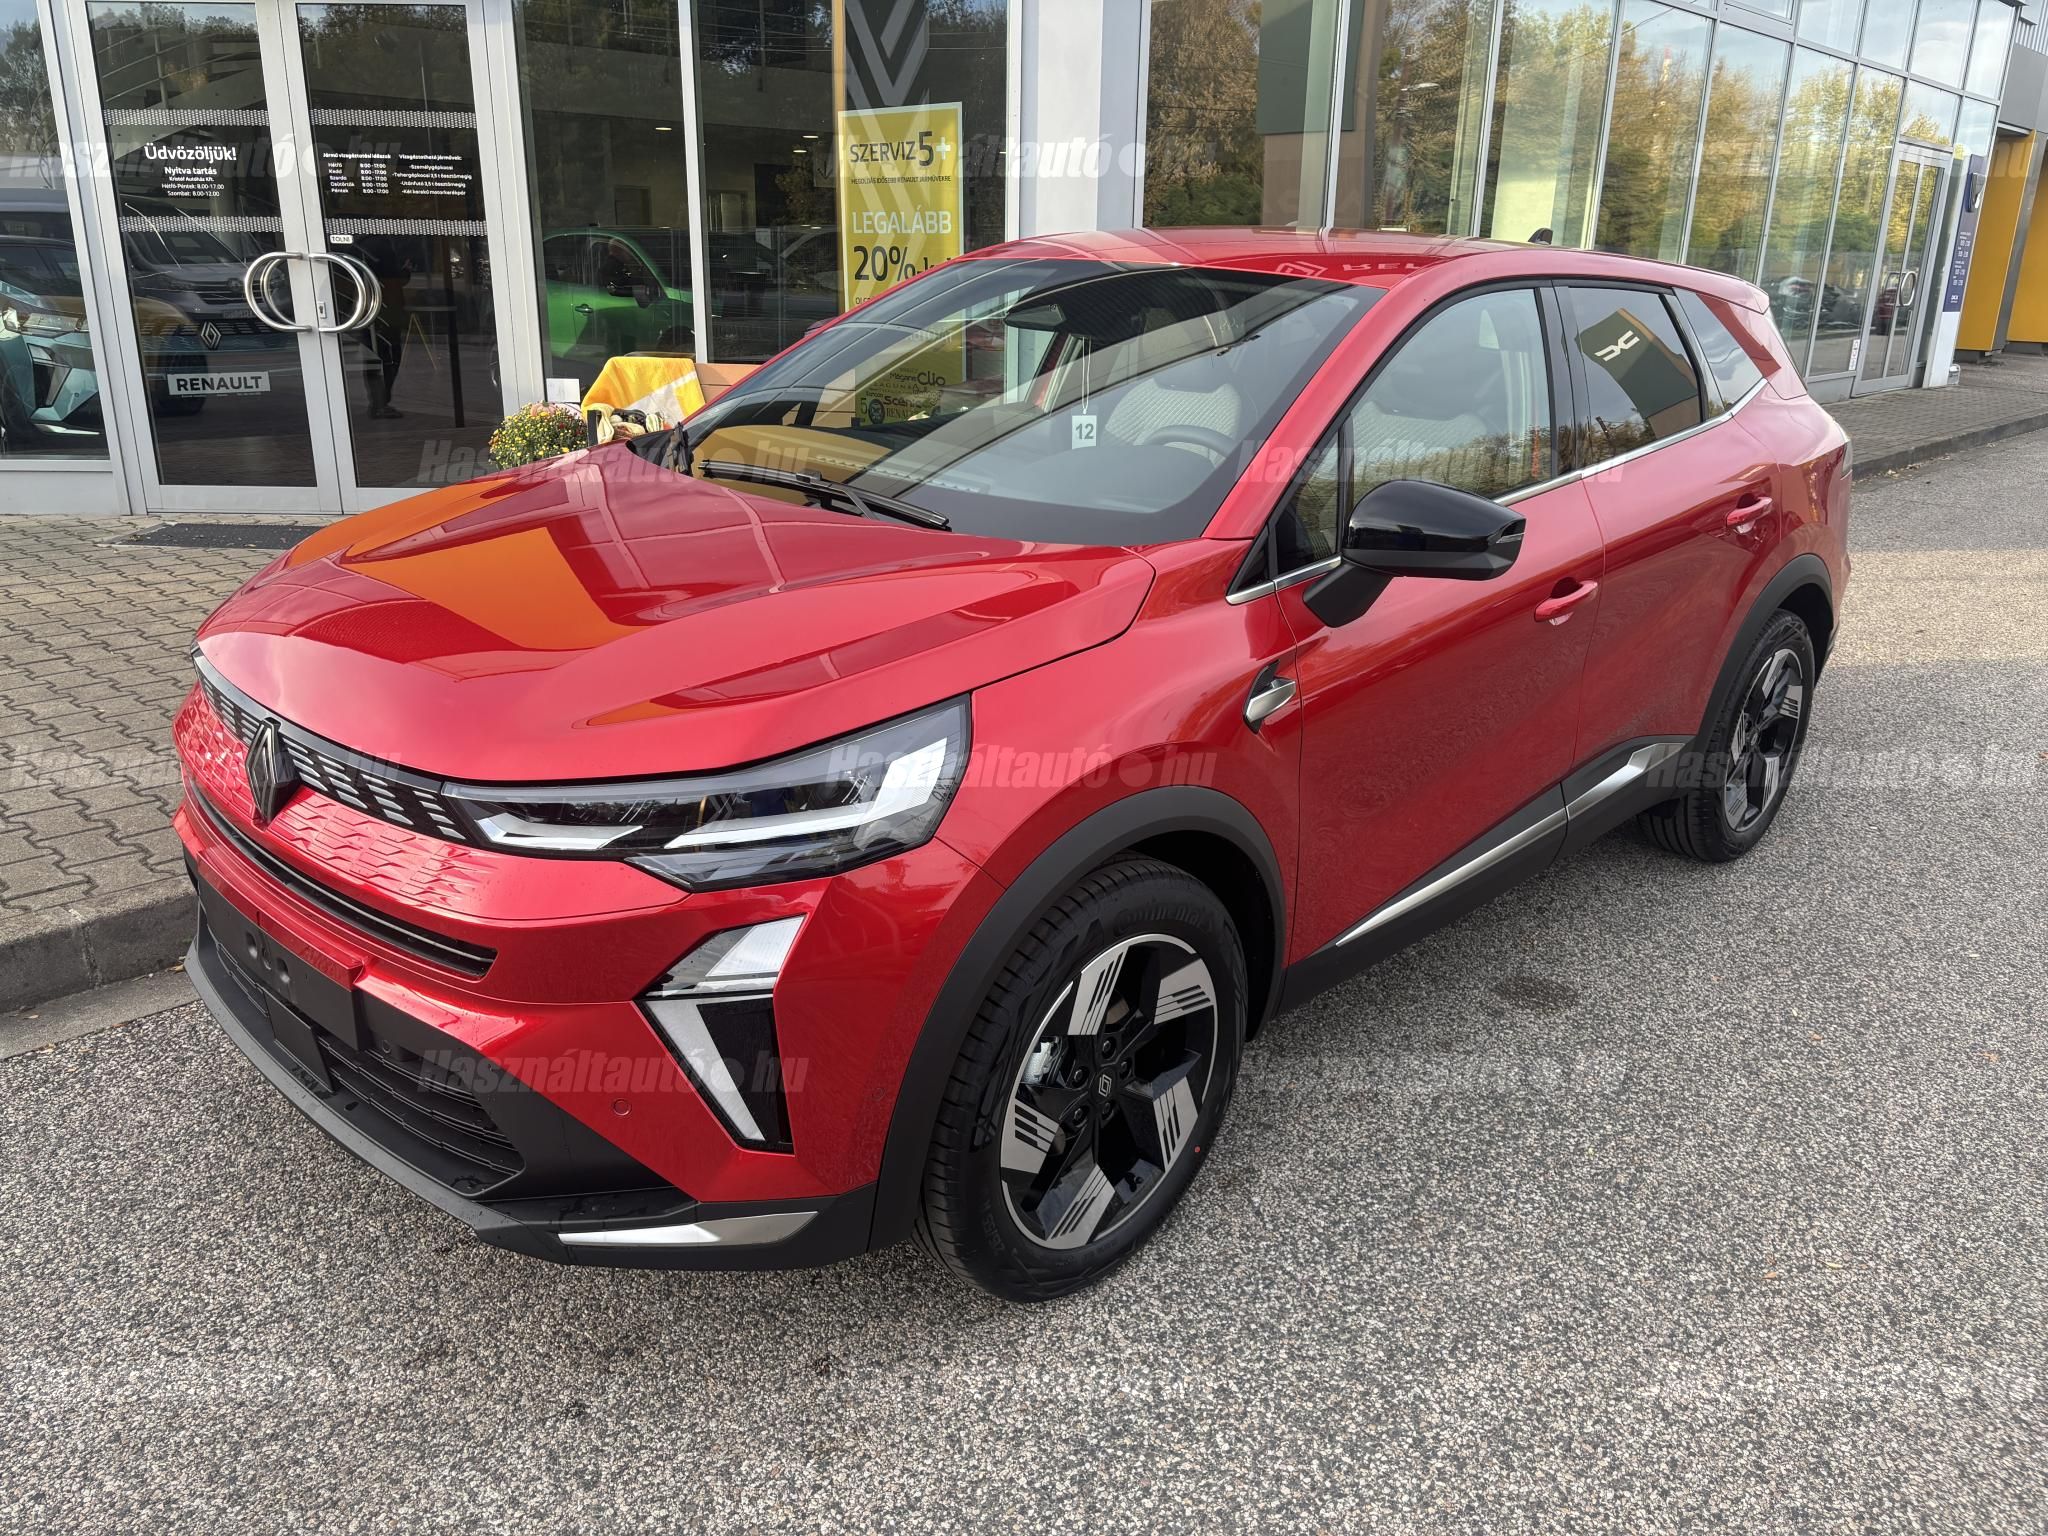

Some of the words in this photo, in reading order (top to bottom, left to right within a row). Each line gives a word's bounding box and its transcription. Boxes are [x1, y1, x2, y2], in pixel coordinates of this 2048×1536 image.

[144, 142, 237, 164] Üdvözöljük!
[850, 141, 916, 162] SZERVIZ
[164, 167, 191, 176] Nyitva
[193, 167, 217, 175] tartás
[852, 204, 952, 234] LEGALÁBB
[176, 376, 262, 391] RENAULT
[917, 371, 946, 386] Clio
[1075, 423, 1095, 440] 12
